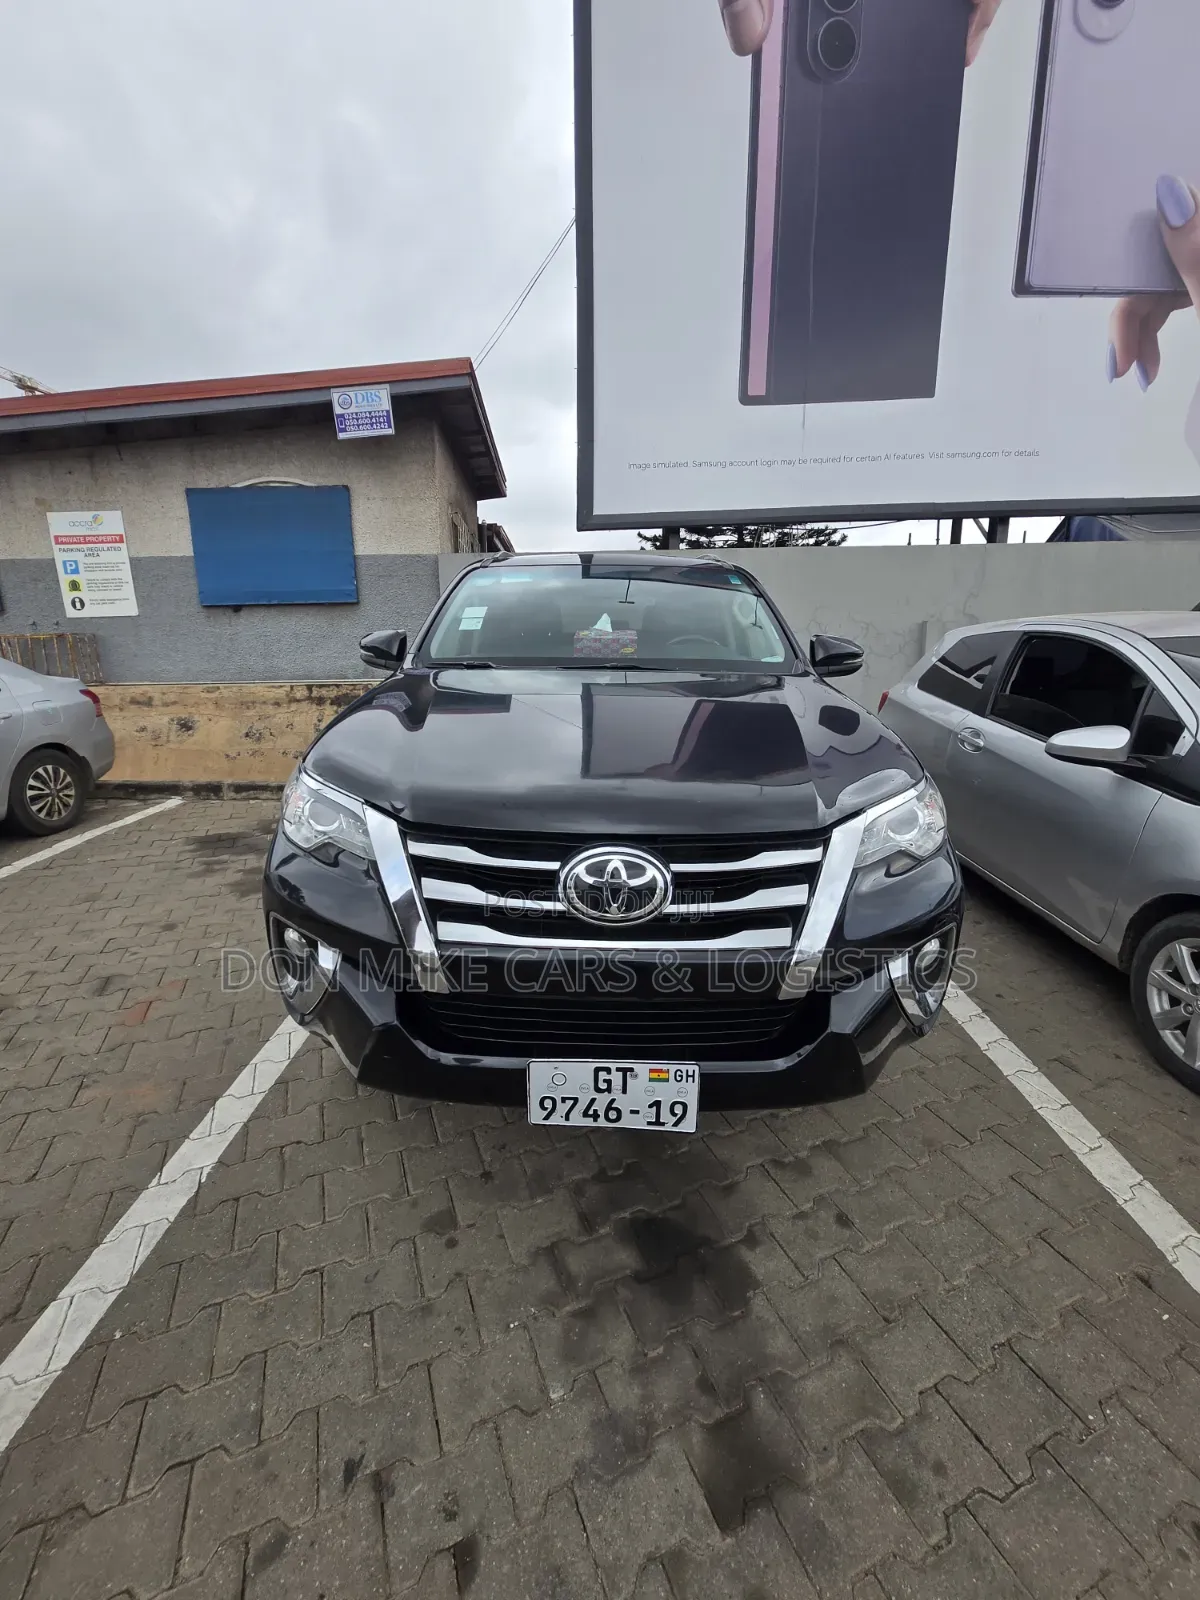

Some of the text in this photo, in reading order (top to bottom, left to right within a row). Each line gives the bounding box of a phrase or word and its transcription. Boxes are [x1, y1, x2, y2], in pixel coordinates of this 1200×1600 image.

[354, 391, 382, 404] DBS
[345, 416, 387, 425] 050.600.4141
[628, 462, 651, 471] Image
[692, 460, 727, 469] Samsung
[729, 459, 758, 467] account
[760, 458, 779, 467] login
[781, 459, 796, 467] may
[798, 457, 808, 465] be
[810, 455, 841, 465] required
[843, 455, 854, 463] for
[856, 454, 882, 462] certain
[884, 453, 892, 461] AI
[928, 451, 945, 459] Visit
[946, 451, 1000, 460] samsung.com
[1001, 449, 1012, 457] for
[66, 561, 76, 573] P
[593, 1066, 696, 1095] GT GH
[538, 1096, 688, 1127] 9746-19
